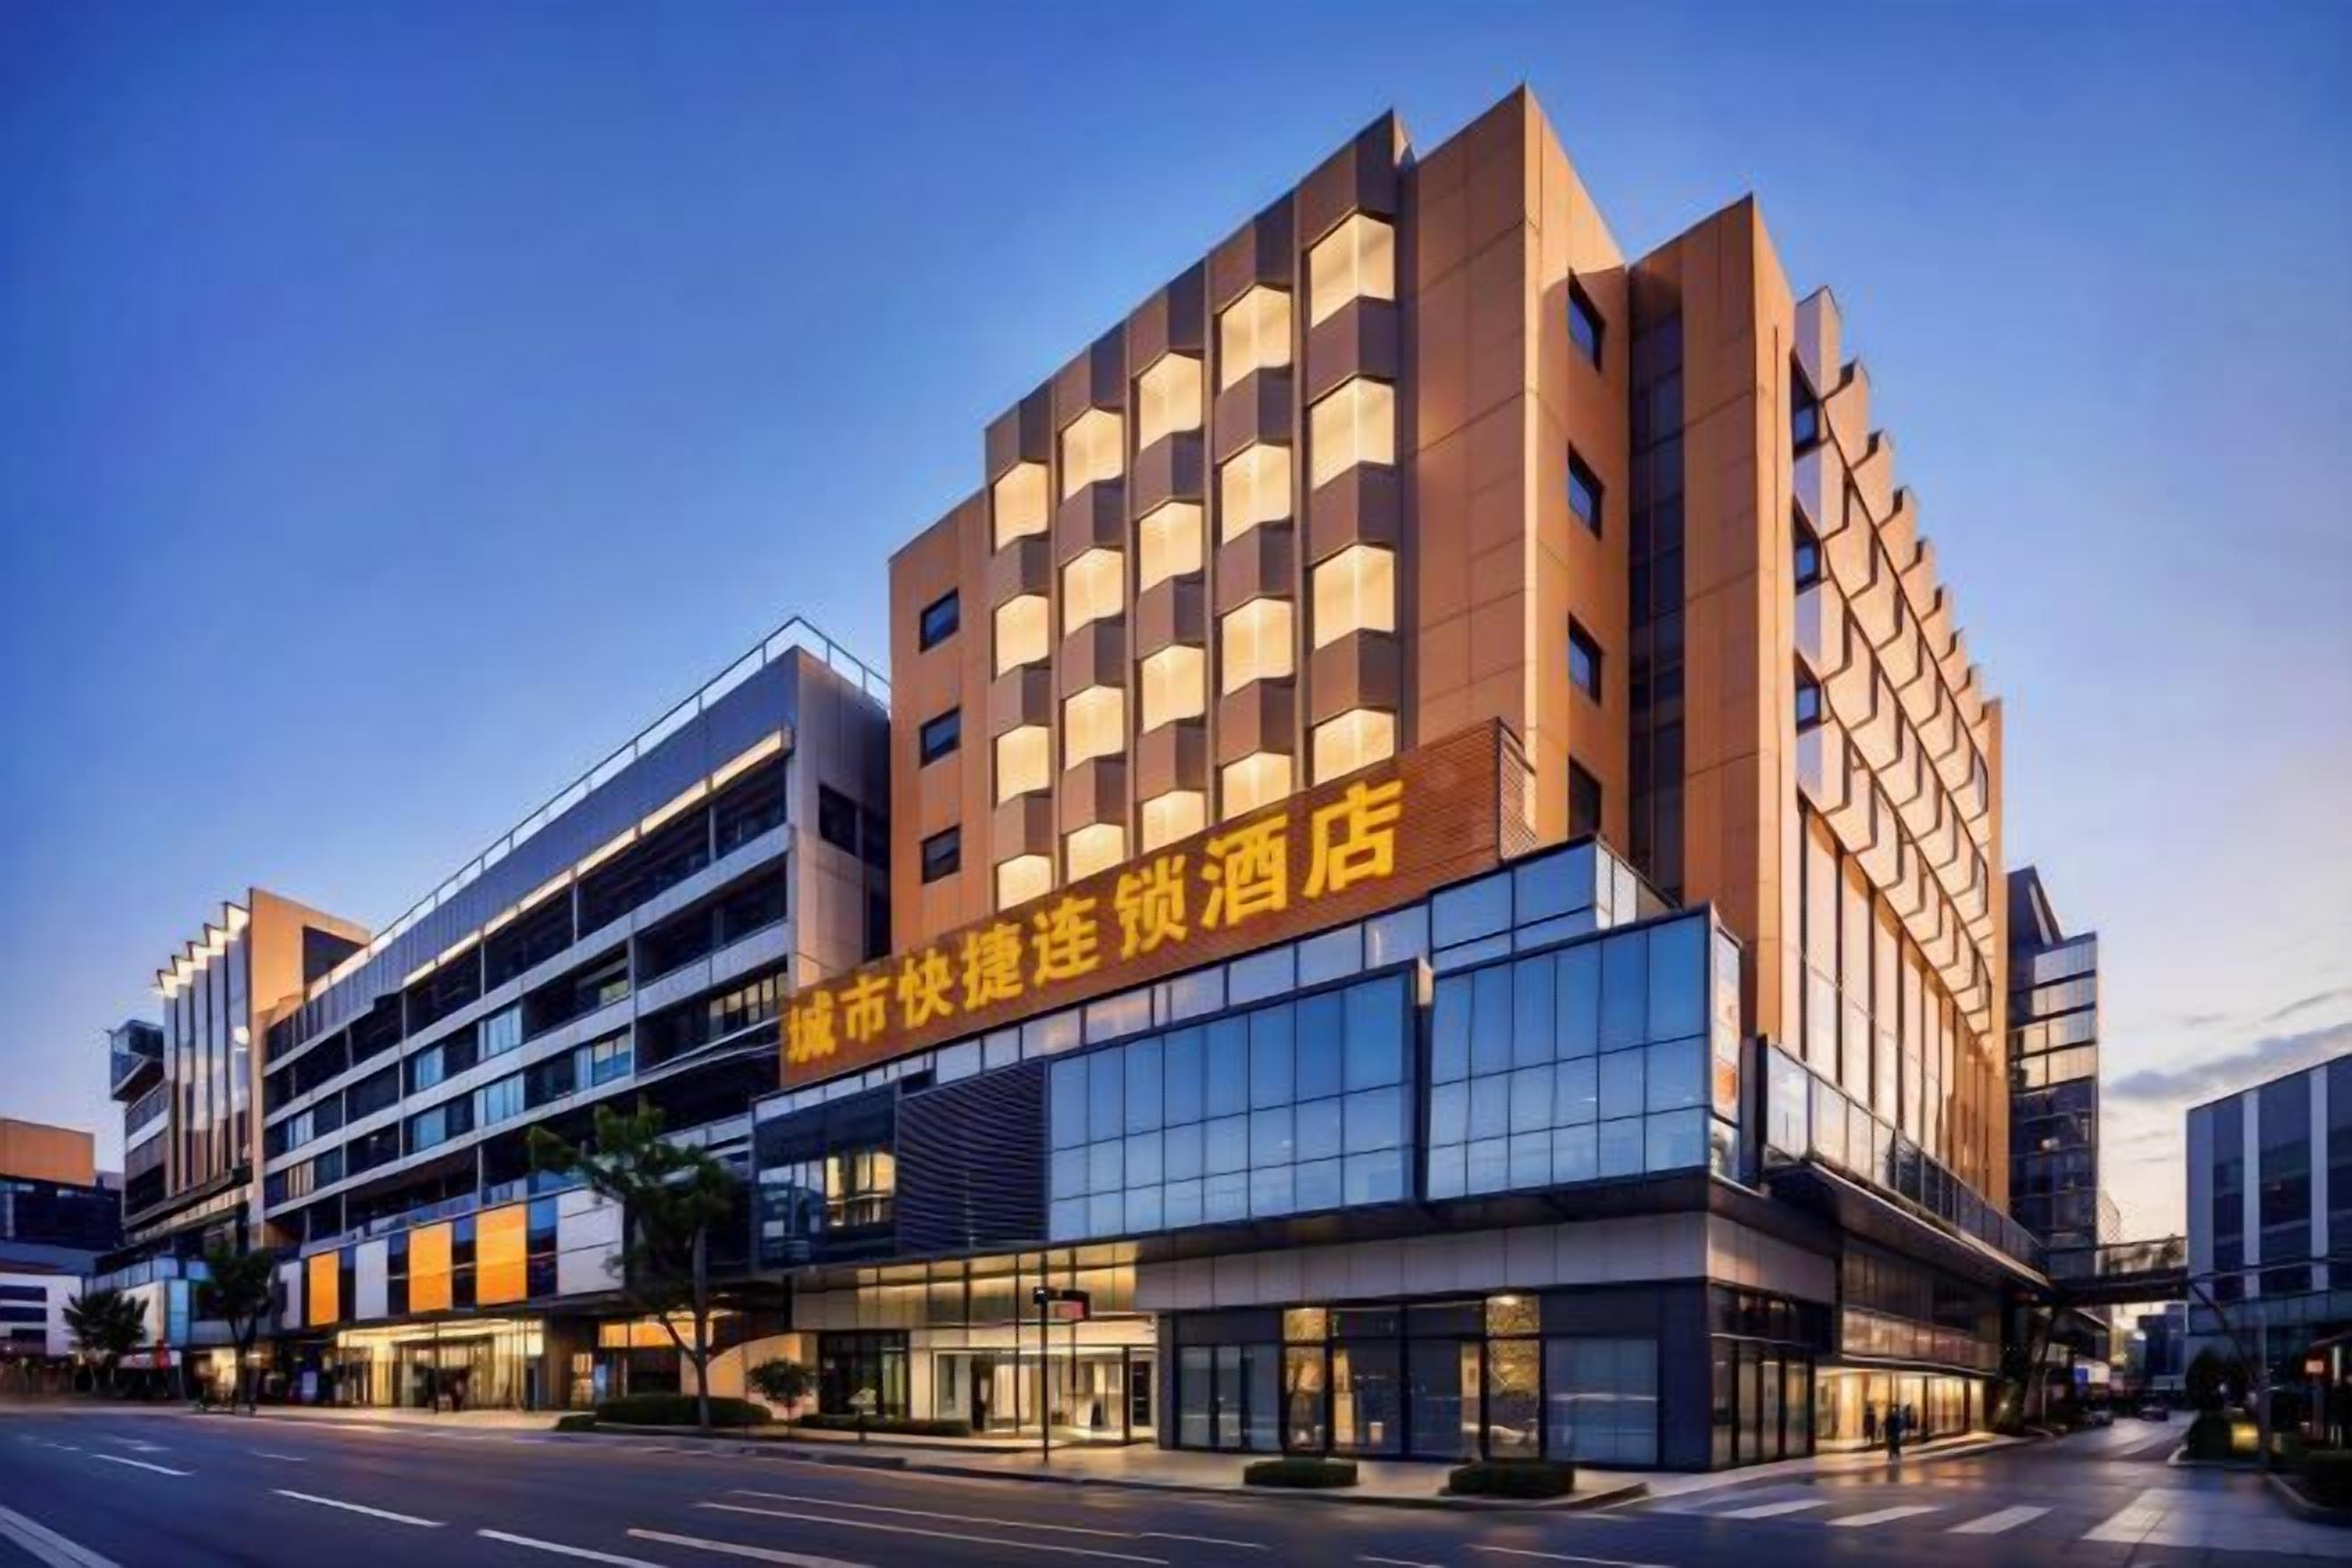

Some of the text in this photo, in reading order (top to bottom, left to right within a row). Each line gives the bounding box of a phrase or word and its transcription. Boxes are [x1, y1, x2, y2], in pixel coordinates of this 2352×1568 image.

[787, 780, 1404, 1064] 城市快捷连锁酒店
